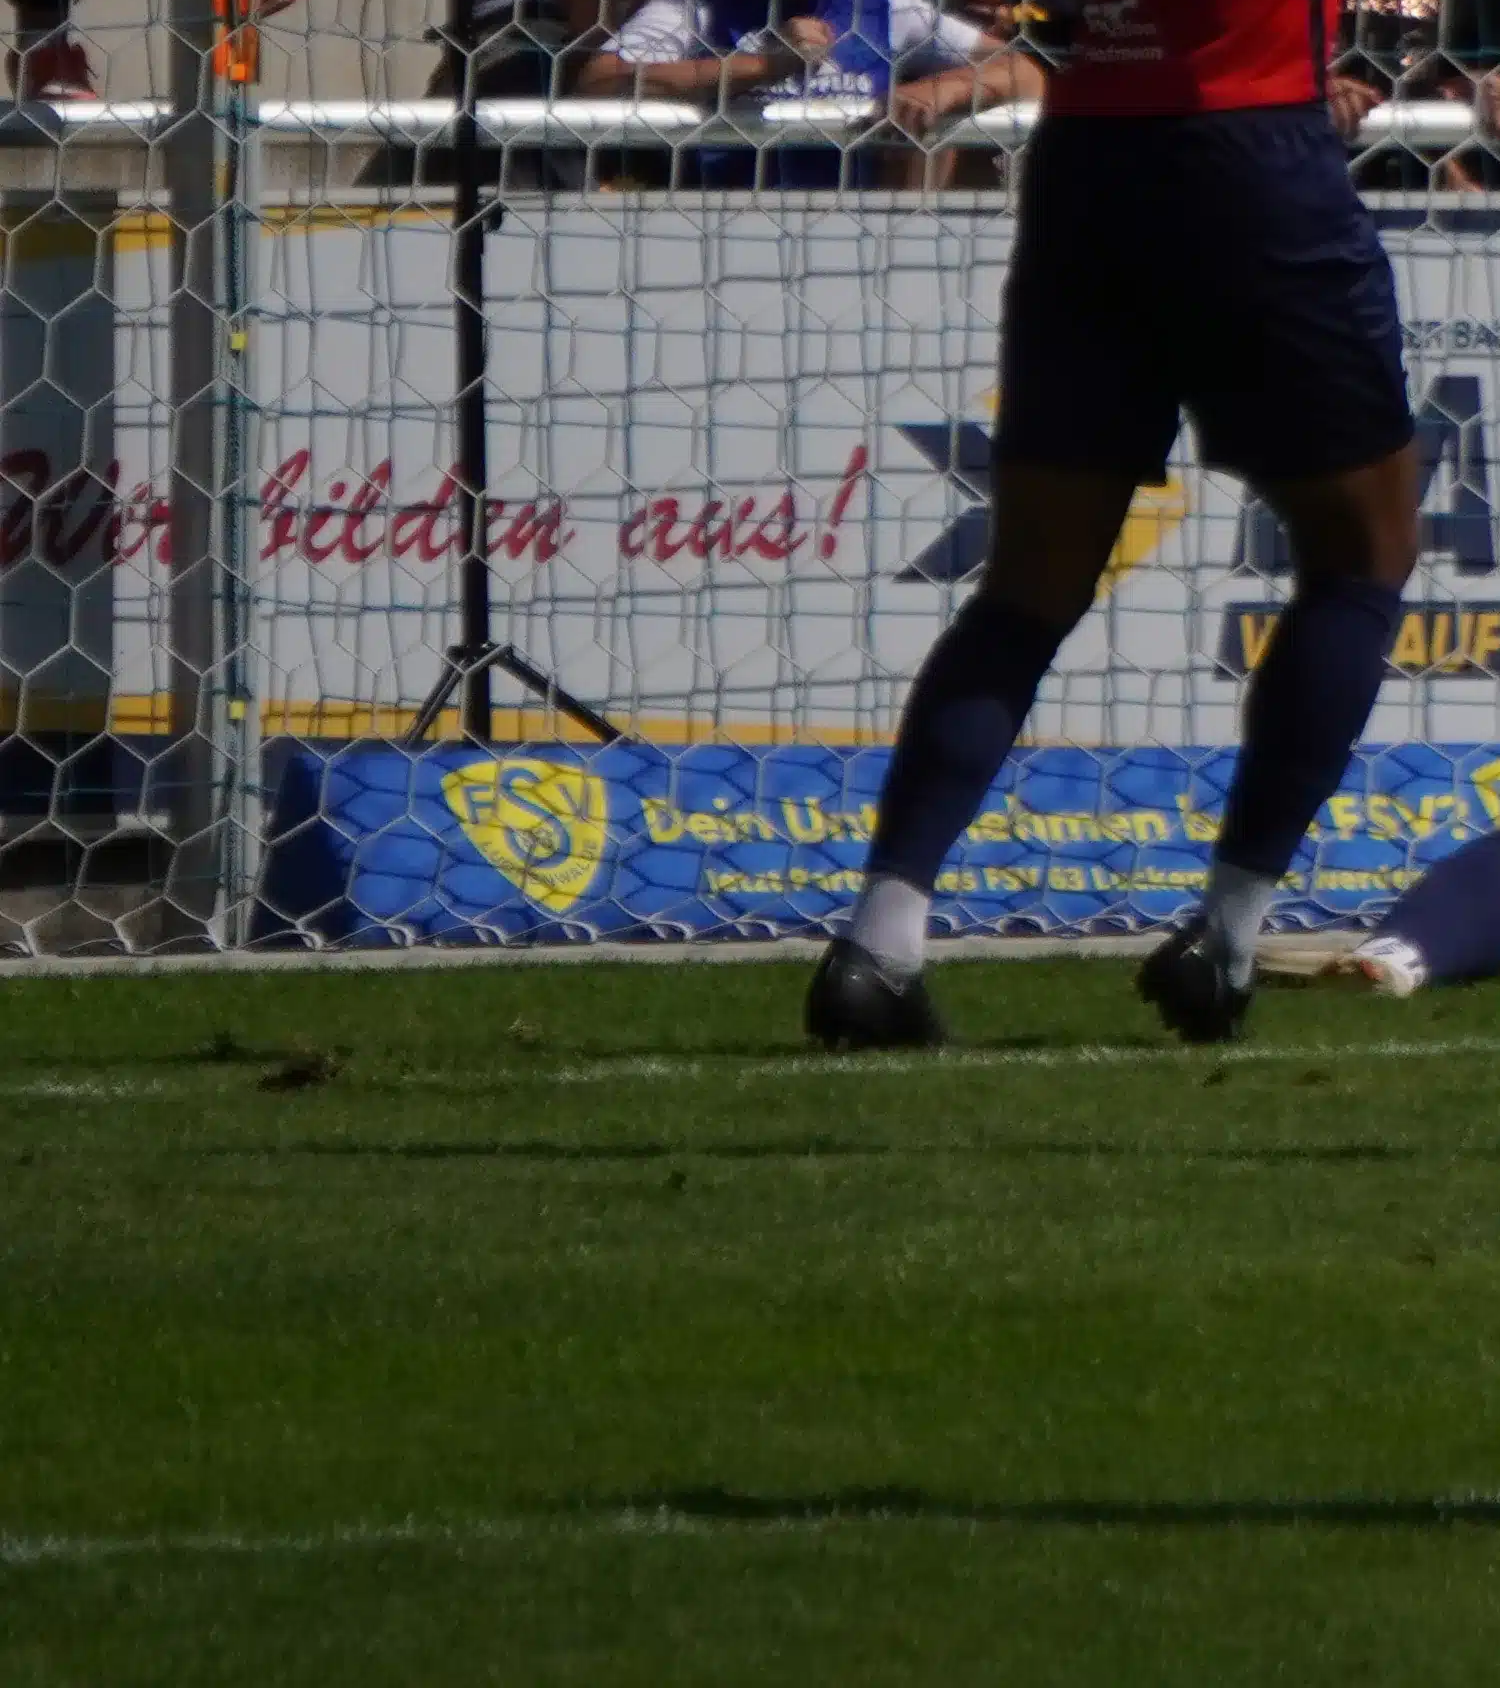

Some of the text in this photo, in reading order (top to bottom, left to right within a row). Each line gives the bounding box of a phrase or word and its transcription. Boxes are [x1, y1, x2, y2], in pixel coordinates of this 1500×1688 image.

[0, 448, 173, 567] Wir
[617, 443, 869, 564] aus!
[640, 796, 773, 845] Dein
